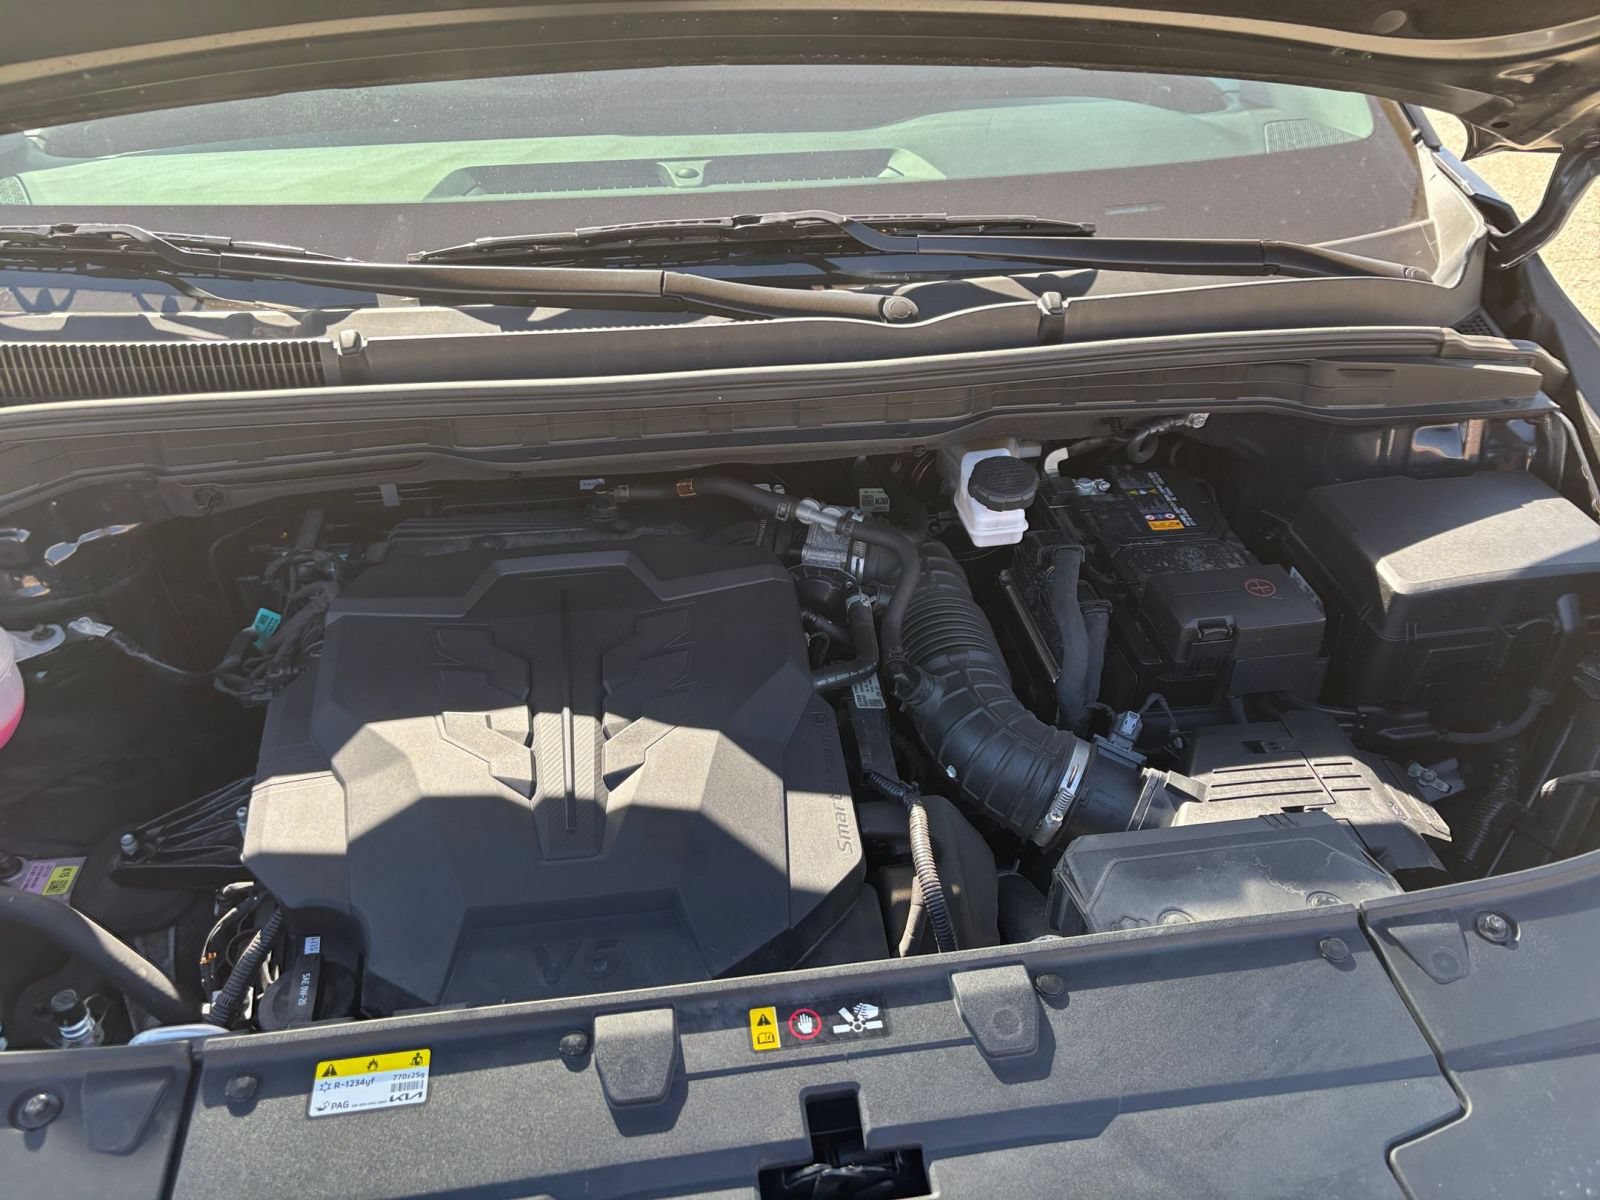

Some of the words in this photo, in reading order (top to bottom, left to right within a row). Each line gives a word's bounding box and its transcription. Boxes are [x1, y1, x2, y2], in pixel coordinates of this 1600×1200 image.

[532, 938, 619, 985] V6
[334, 1077, 375, 1090] R-1234yf
[331, 1101, 350, 1110] PAG
